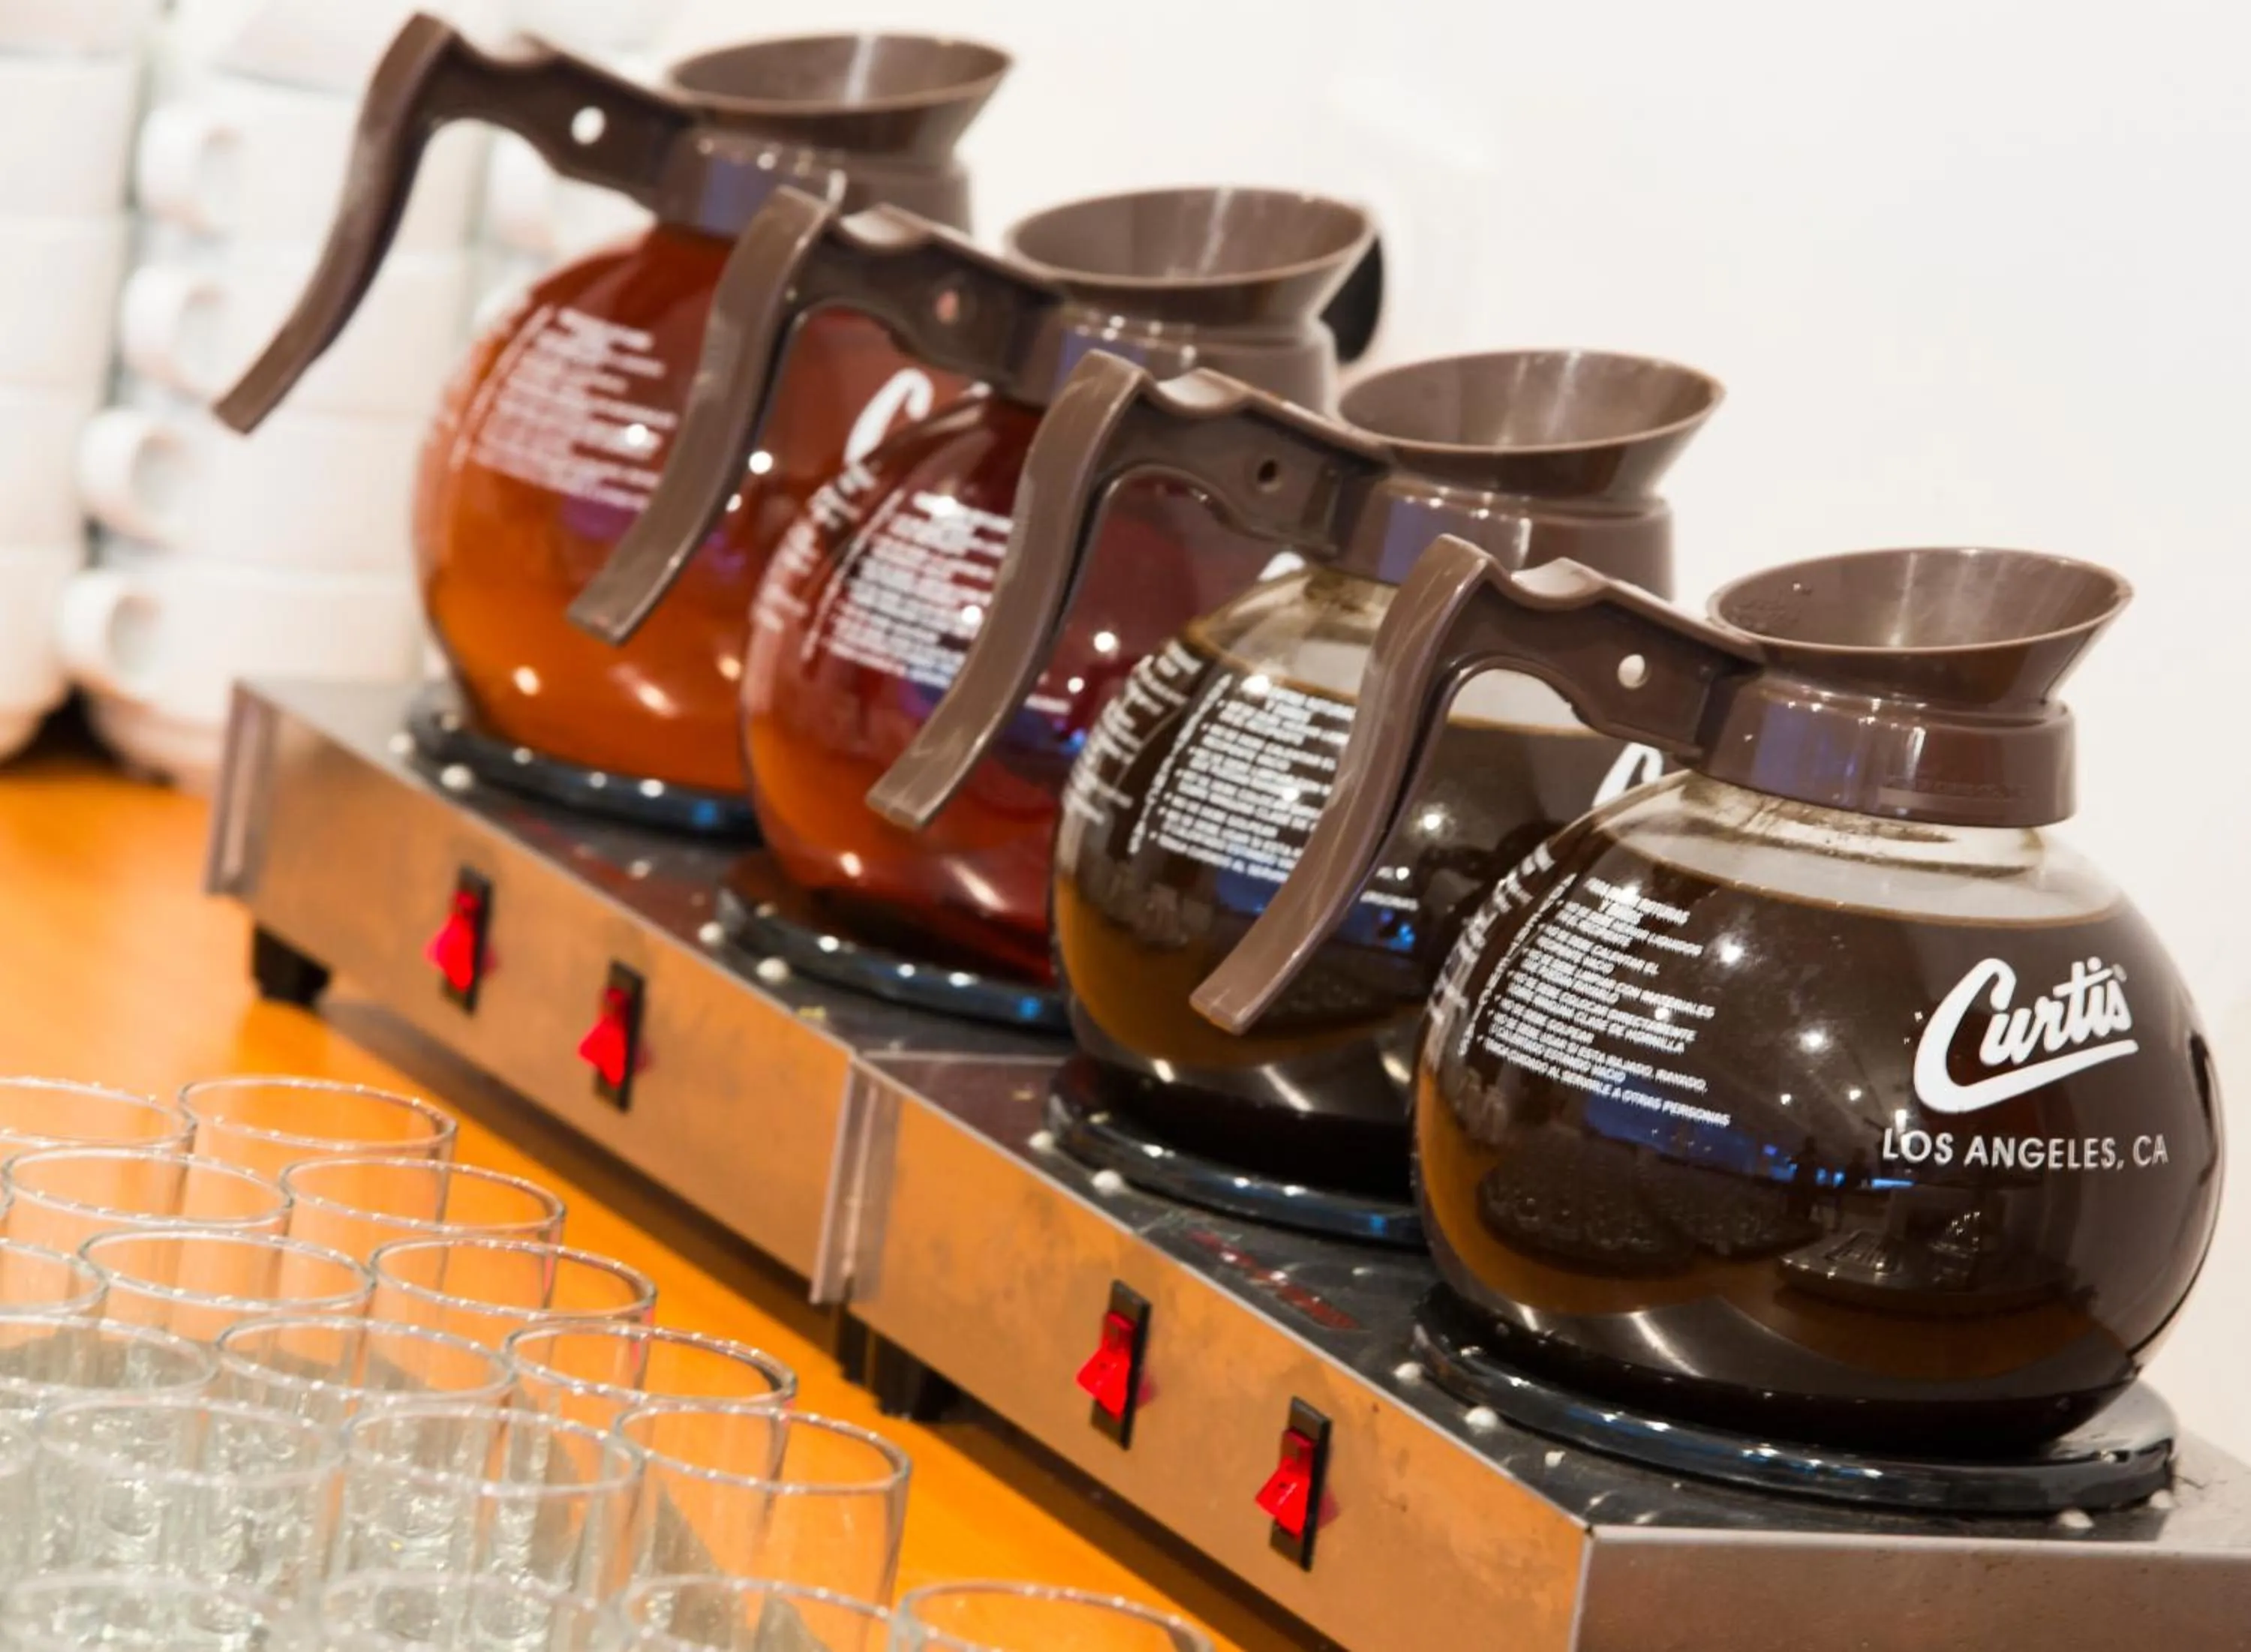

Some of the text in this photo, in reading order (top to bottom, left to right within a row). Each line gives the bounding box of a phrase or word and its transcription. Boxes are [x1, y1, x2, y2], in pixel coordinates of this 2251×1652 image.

[1914, 957, 2139, 1113] Curtis
[1882, 1128, 2169, 1170] LOS ANGELES, CA
